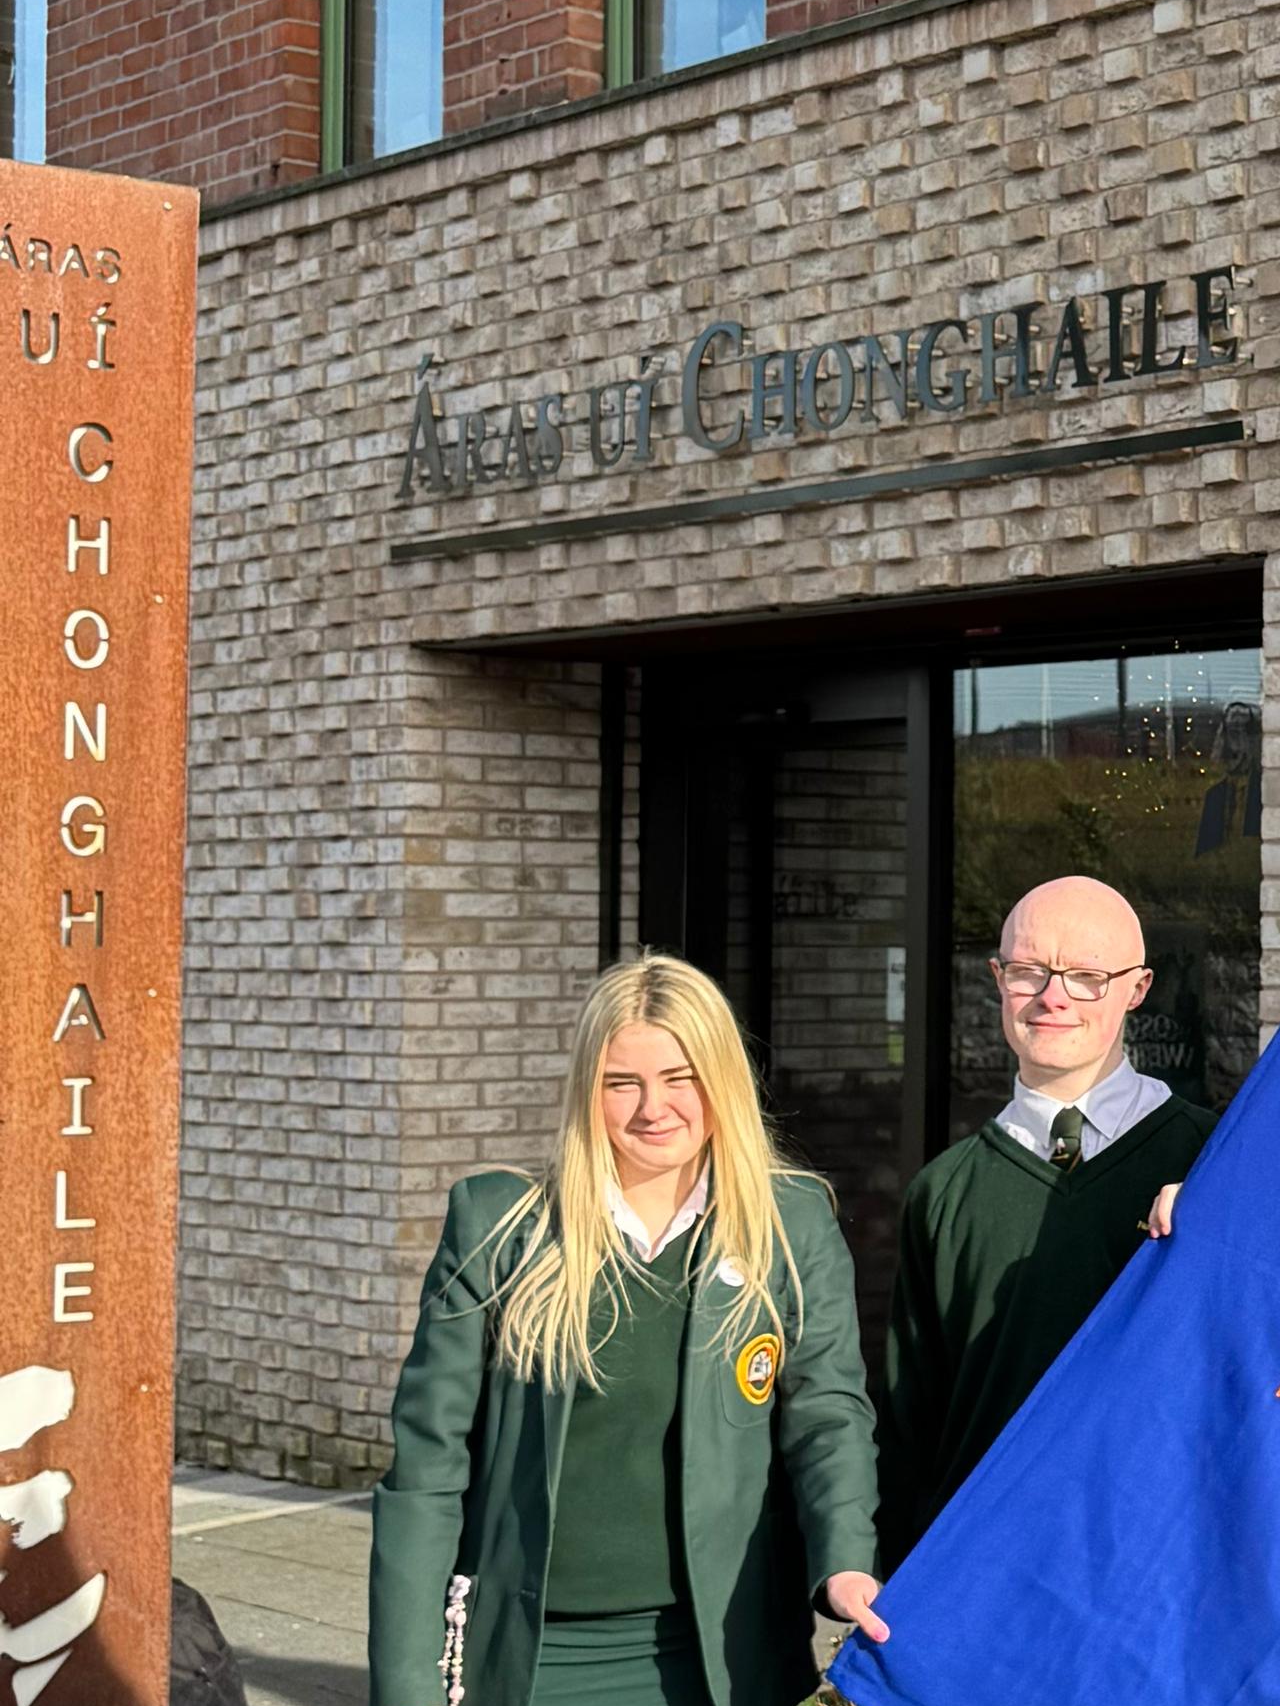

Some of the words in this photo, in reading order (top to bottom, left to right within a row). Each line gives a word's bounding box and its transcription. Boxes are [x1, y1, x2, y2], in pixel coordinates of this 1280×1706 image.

[0, 223, 122, 285] ÁRAS
[20, 302, 117, 371] UÍ
[395, 353, 563, 498] ÁRAS
[682, 265, 1243, 451] CHONGHAILE
